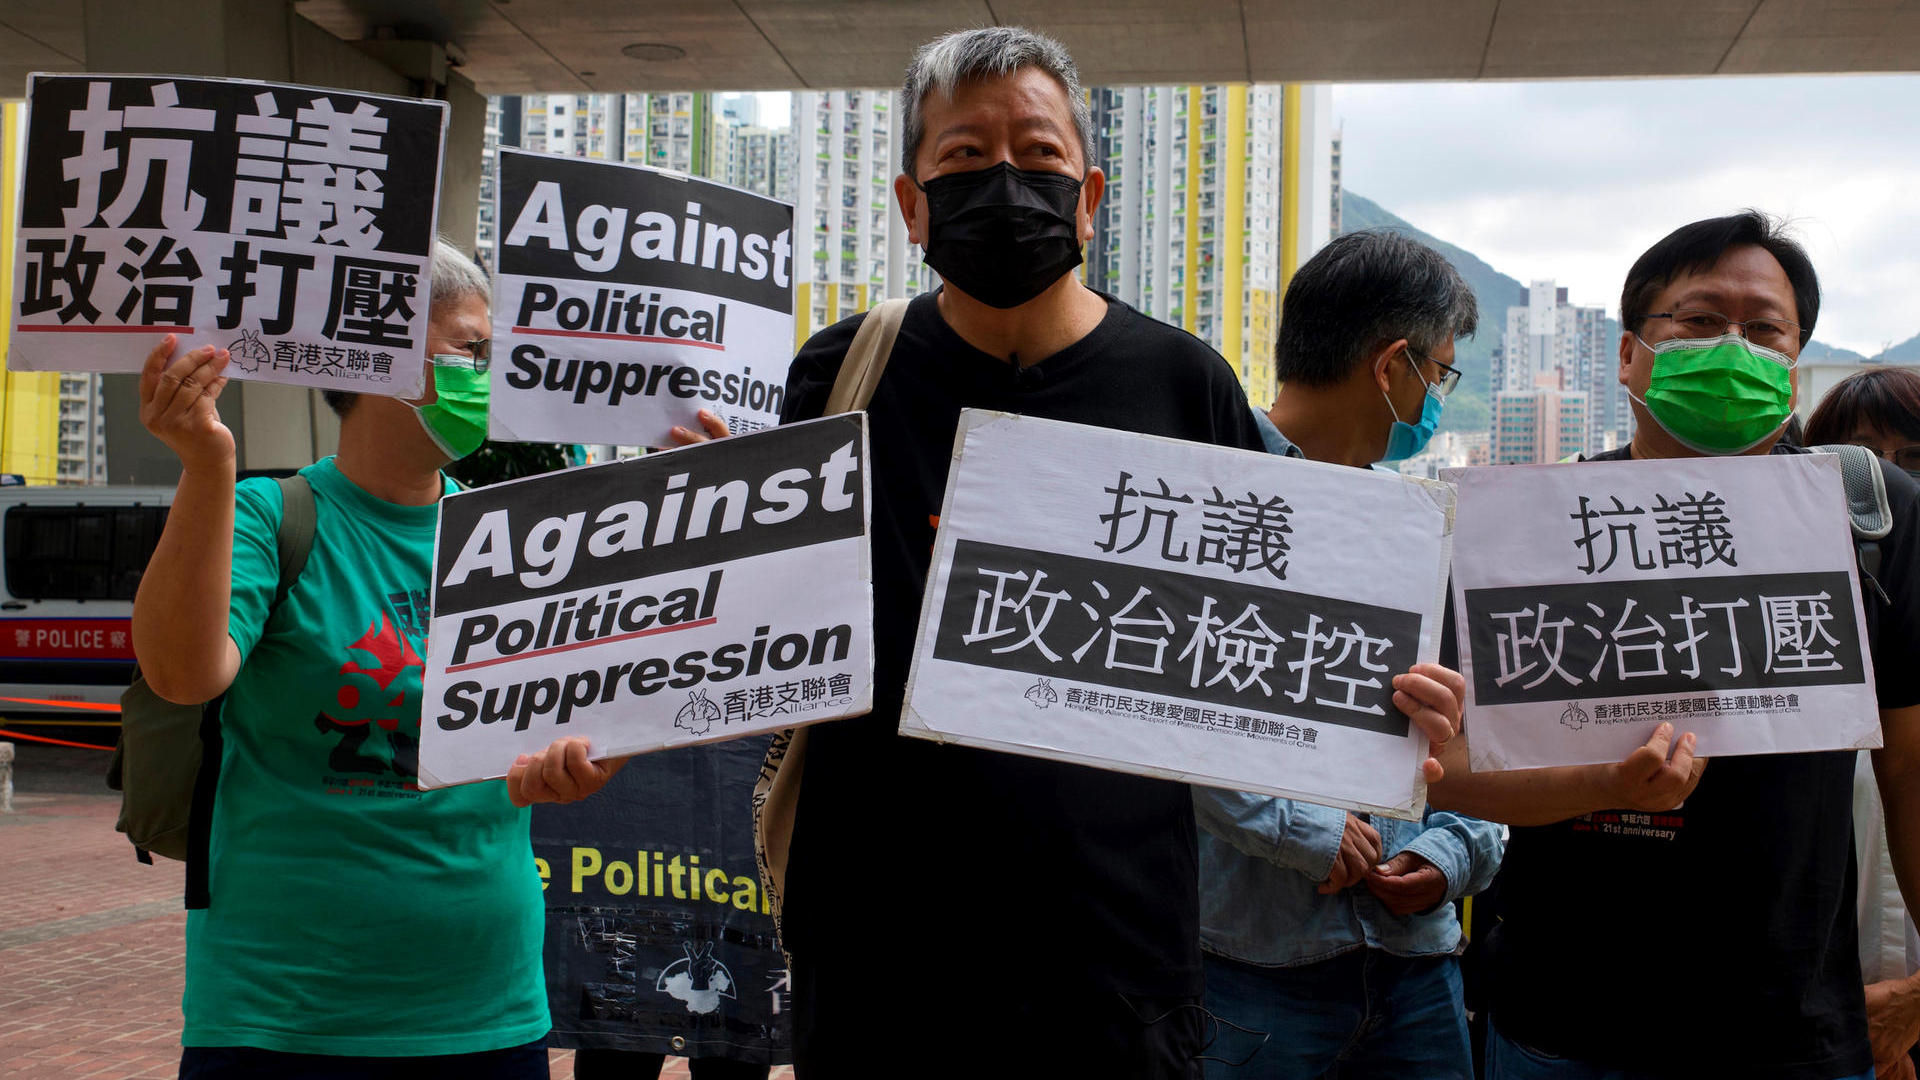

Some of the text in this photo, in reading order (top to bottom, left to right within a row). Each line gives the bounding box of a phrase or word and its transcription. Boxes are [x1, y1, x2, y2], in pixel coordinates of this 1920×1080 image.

[62, 81, 388, 251] 抗議
[504, 181, 791, 288] Against
[20, 234, 420, 349] 政治打壓
[516, 282, 727, 344] Political
[273, 340, 394, 374] 香港支聯會
[505, 344, 784, 415] Suppression
[442, 439, 858, 588] Against
[1094, 471, 1294, 580] 抗議
[1570, 490, 1737, 575] 抗議
[36, 629, 104, 648] POLICE
[450, 569, 724, 665] Political
[962, 566, 1394, 716] 政治檢控
[1490, 591, 1843, 690] 政治打壓
[436, 624, 852, 732] Suppression
[723, 673, 852, 715] 香港支聯會
[1064, 702, 1084, 712] Hong
[1085, 705, 1104, 716] Kong
[1140, 714, 1168, 725] Support
[1066, 688, 1318, 743] 香港市民支援愛國民主運動聯合會
[1594, 693, 1799, 719] 香港市民支援愛國民主運動聯合會
[1603, 823, 1621, 834] 21st
[1623, 825, 1676, 840] anniversary
